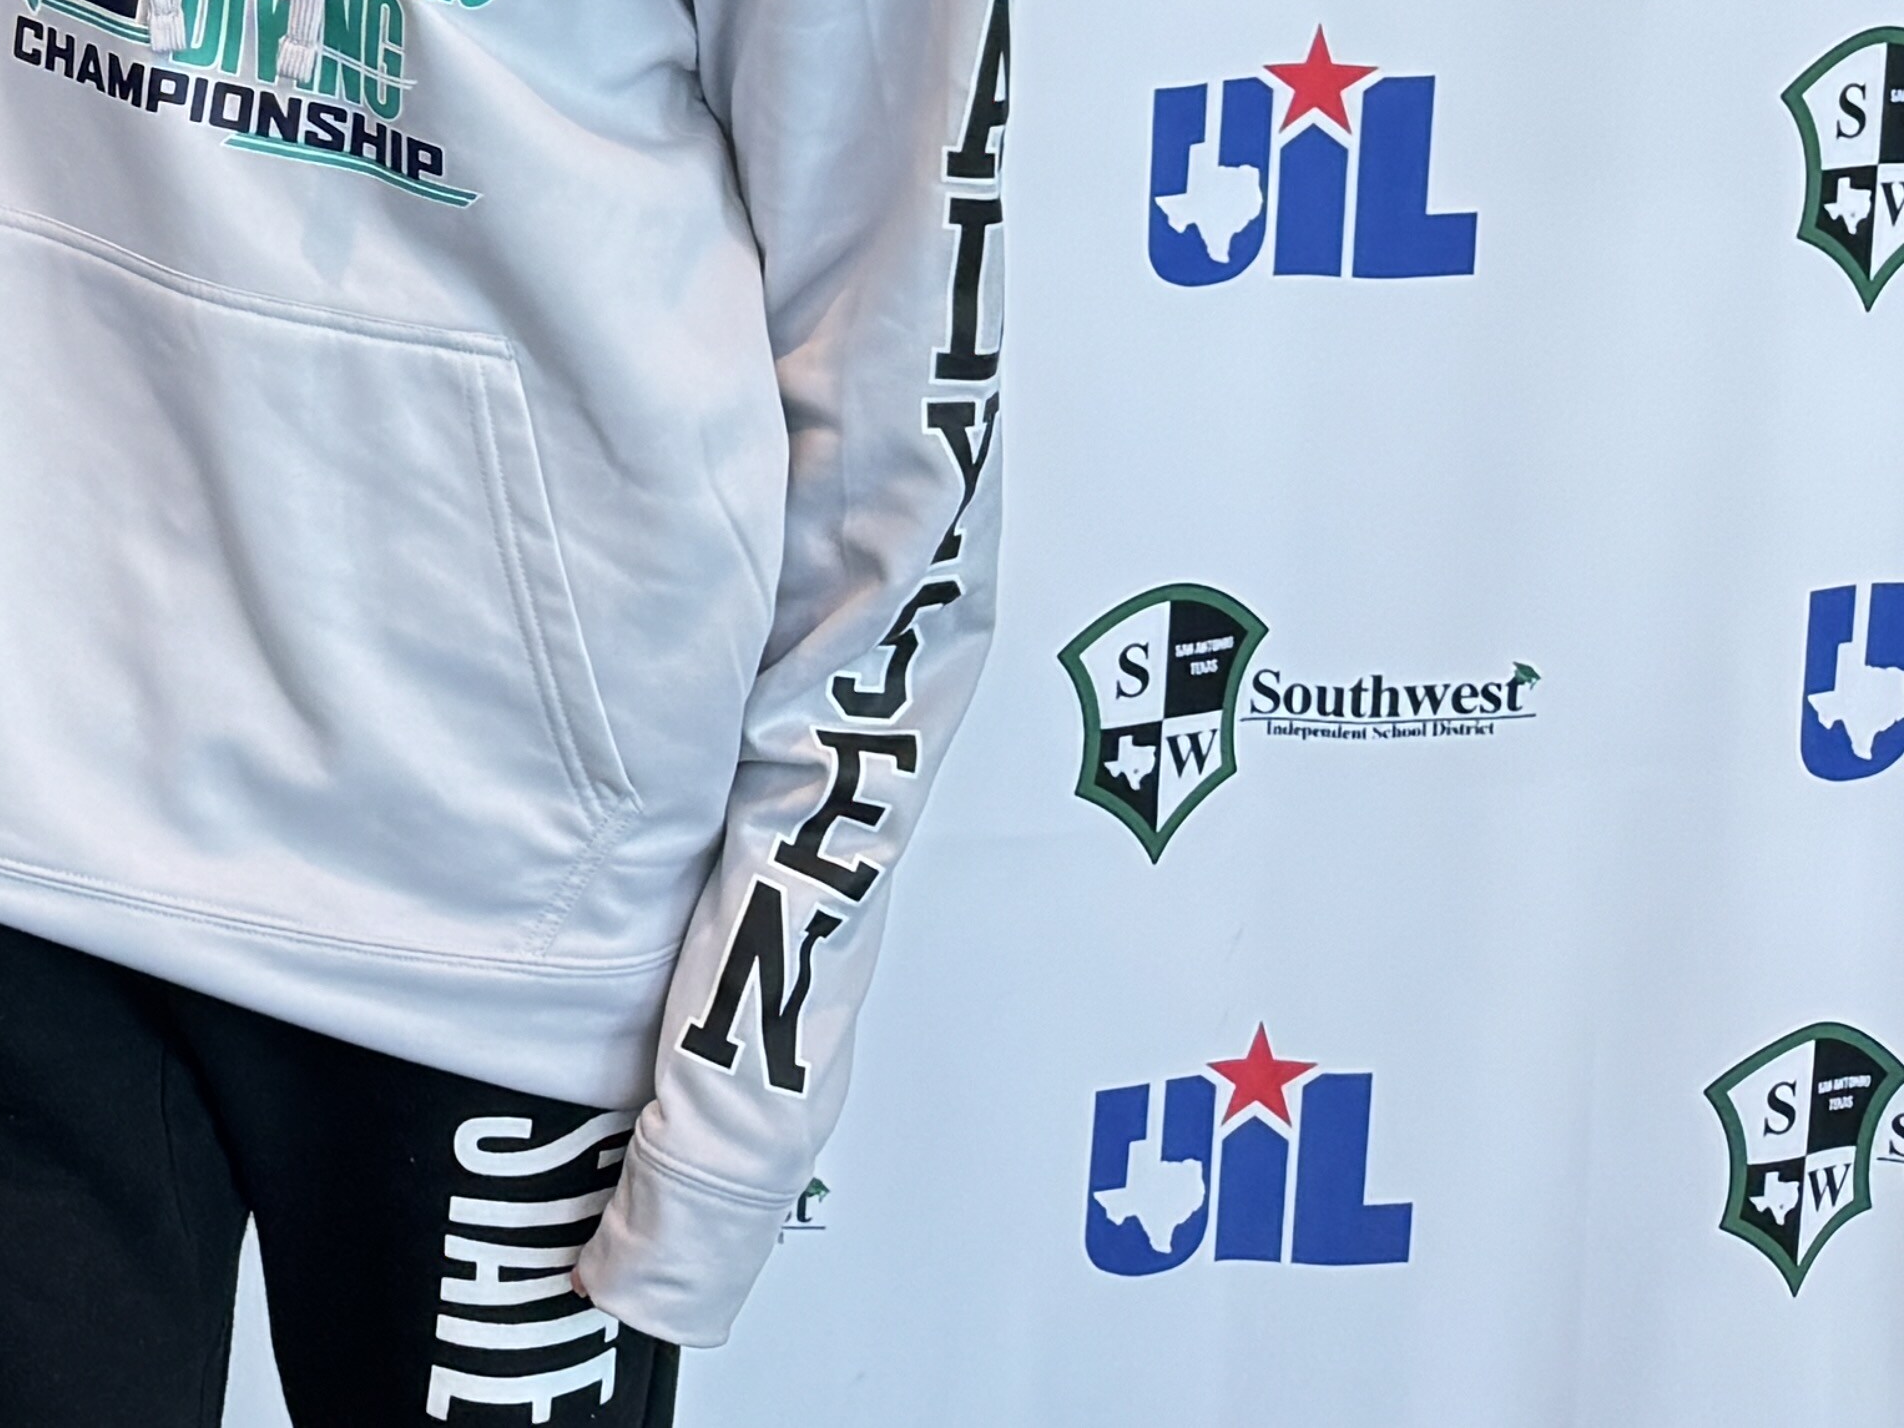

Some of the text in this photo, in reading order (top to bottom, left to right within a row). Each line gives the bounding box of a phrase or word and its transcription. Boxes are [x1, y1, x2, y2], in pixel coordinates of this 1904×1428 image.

[12, 14, 444, 180] CHAMPIONSHIP
[1837, 82, 1874, 140] S
[1115, 642, 1151, 702] S
[1249, 662, 1524, 719] Southwest
[1166, 728, 1218, 777] W
[1763, 1083, 1798, 1138] S
[1807, 1163, 1851, 1210] W
